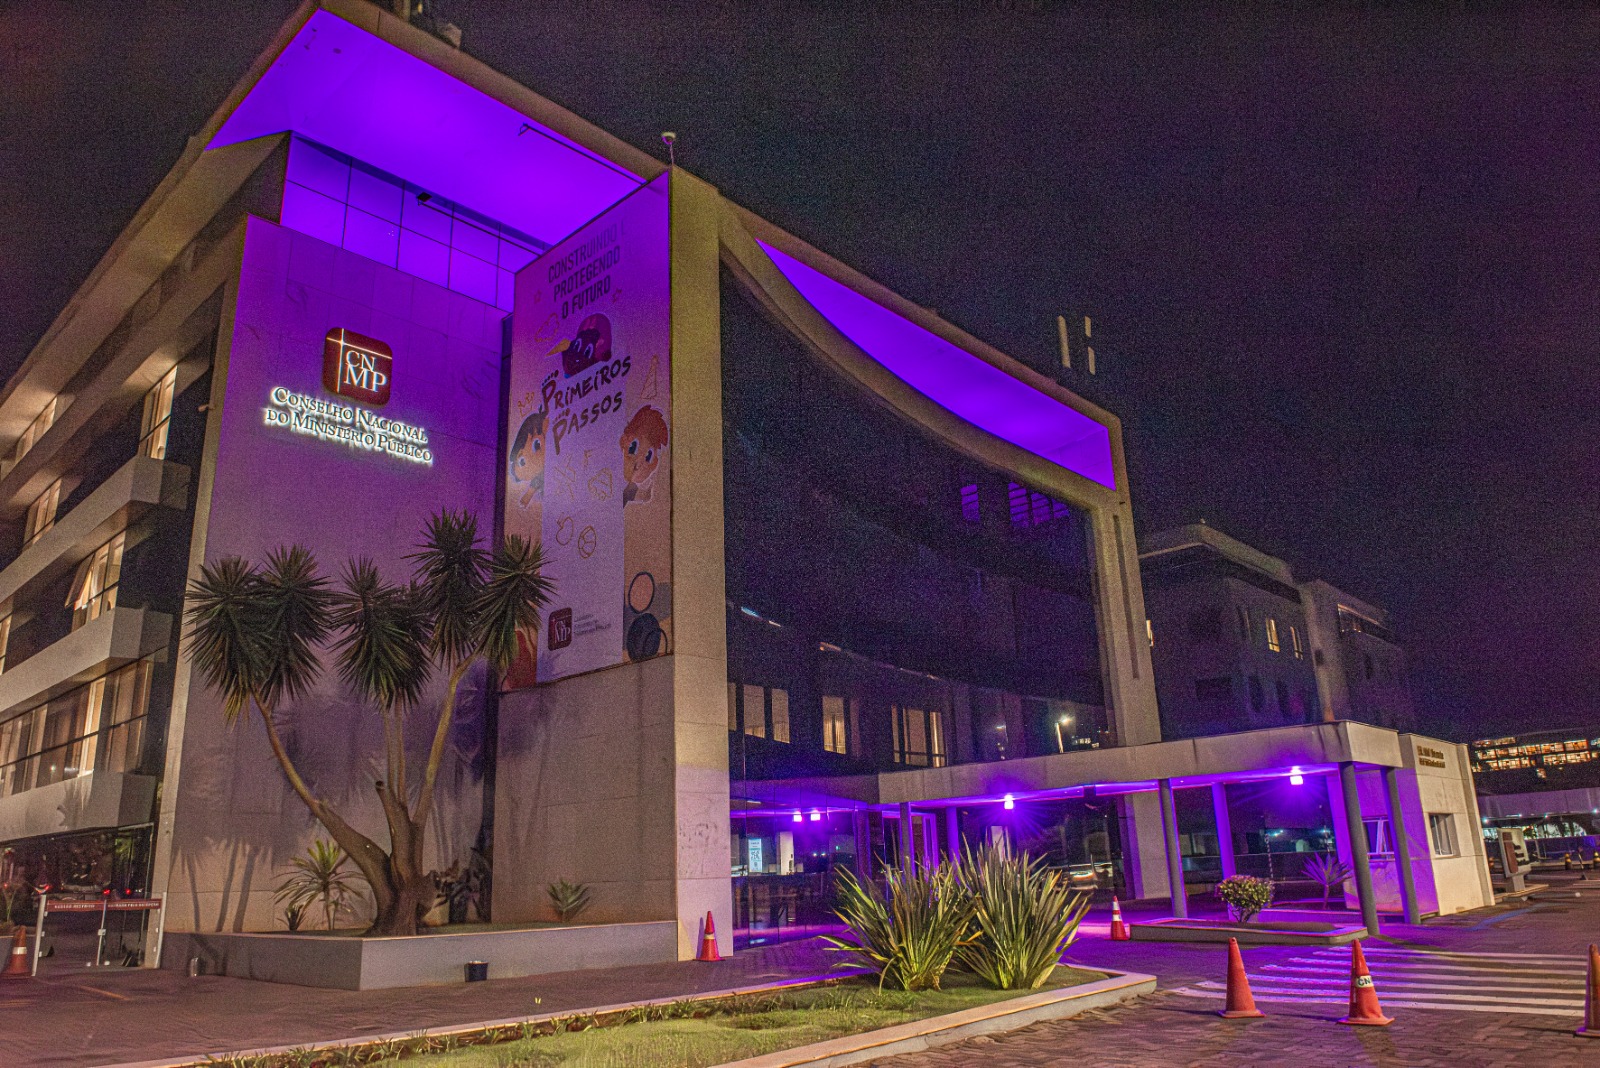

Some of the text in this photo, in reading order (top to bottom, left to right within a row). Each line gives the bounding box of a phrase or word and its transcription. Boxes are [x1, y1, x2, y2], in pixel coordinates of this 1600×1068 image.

[548, 223, 618, 284] CONSTRUINDO
[553, 245, 621, 302] PROTEGENDO
[562, 275, 611, 320] O FUTURO
[343, 363, 388, 393] MP
[345, 350, 377, 372] CN
[541, 355, 632, 415] PRIMEIROS
[266, 408, 433, 463] DO MINISTÉRIO PÚBLICO
[270, 386, 429, 443] CONSELHO NACIONAL
[552, 391, 623, 456] PASSOS
